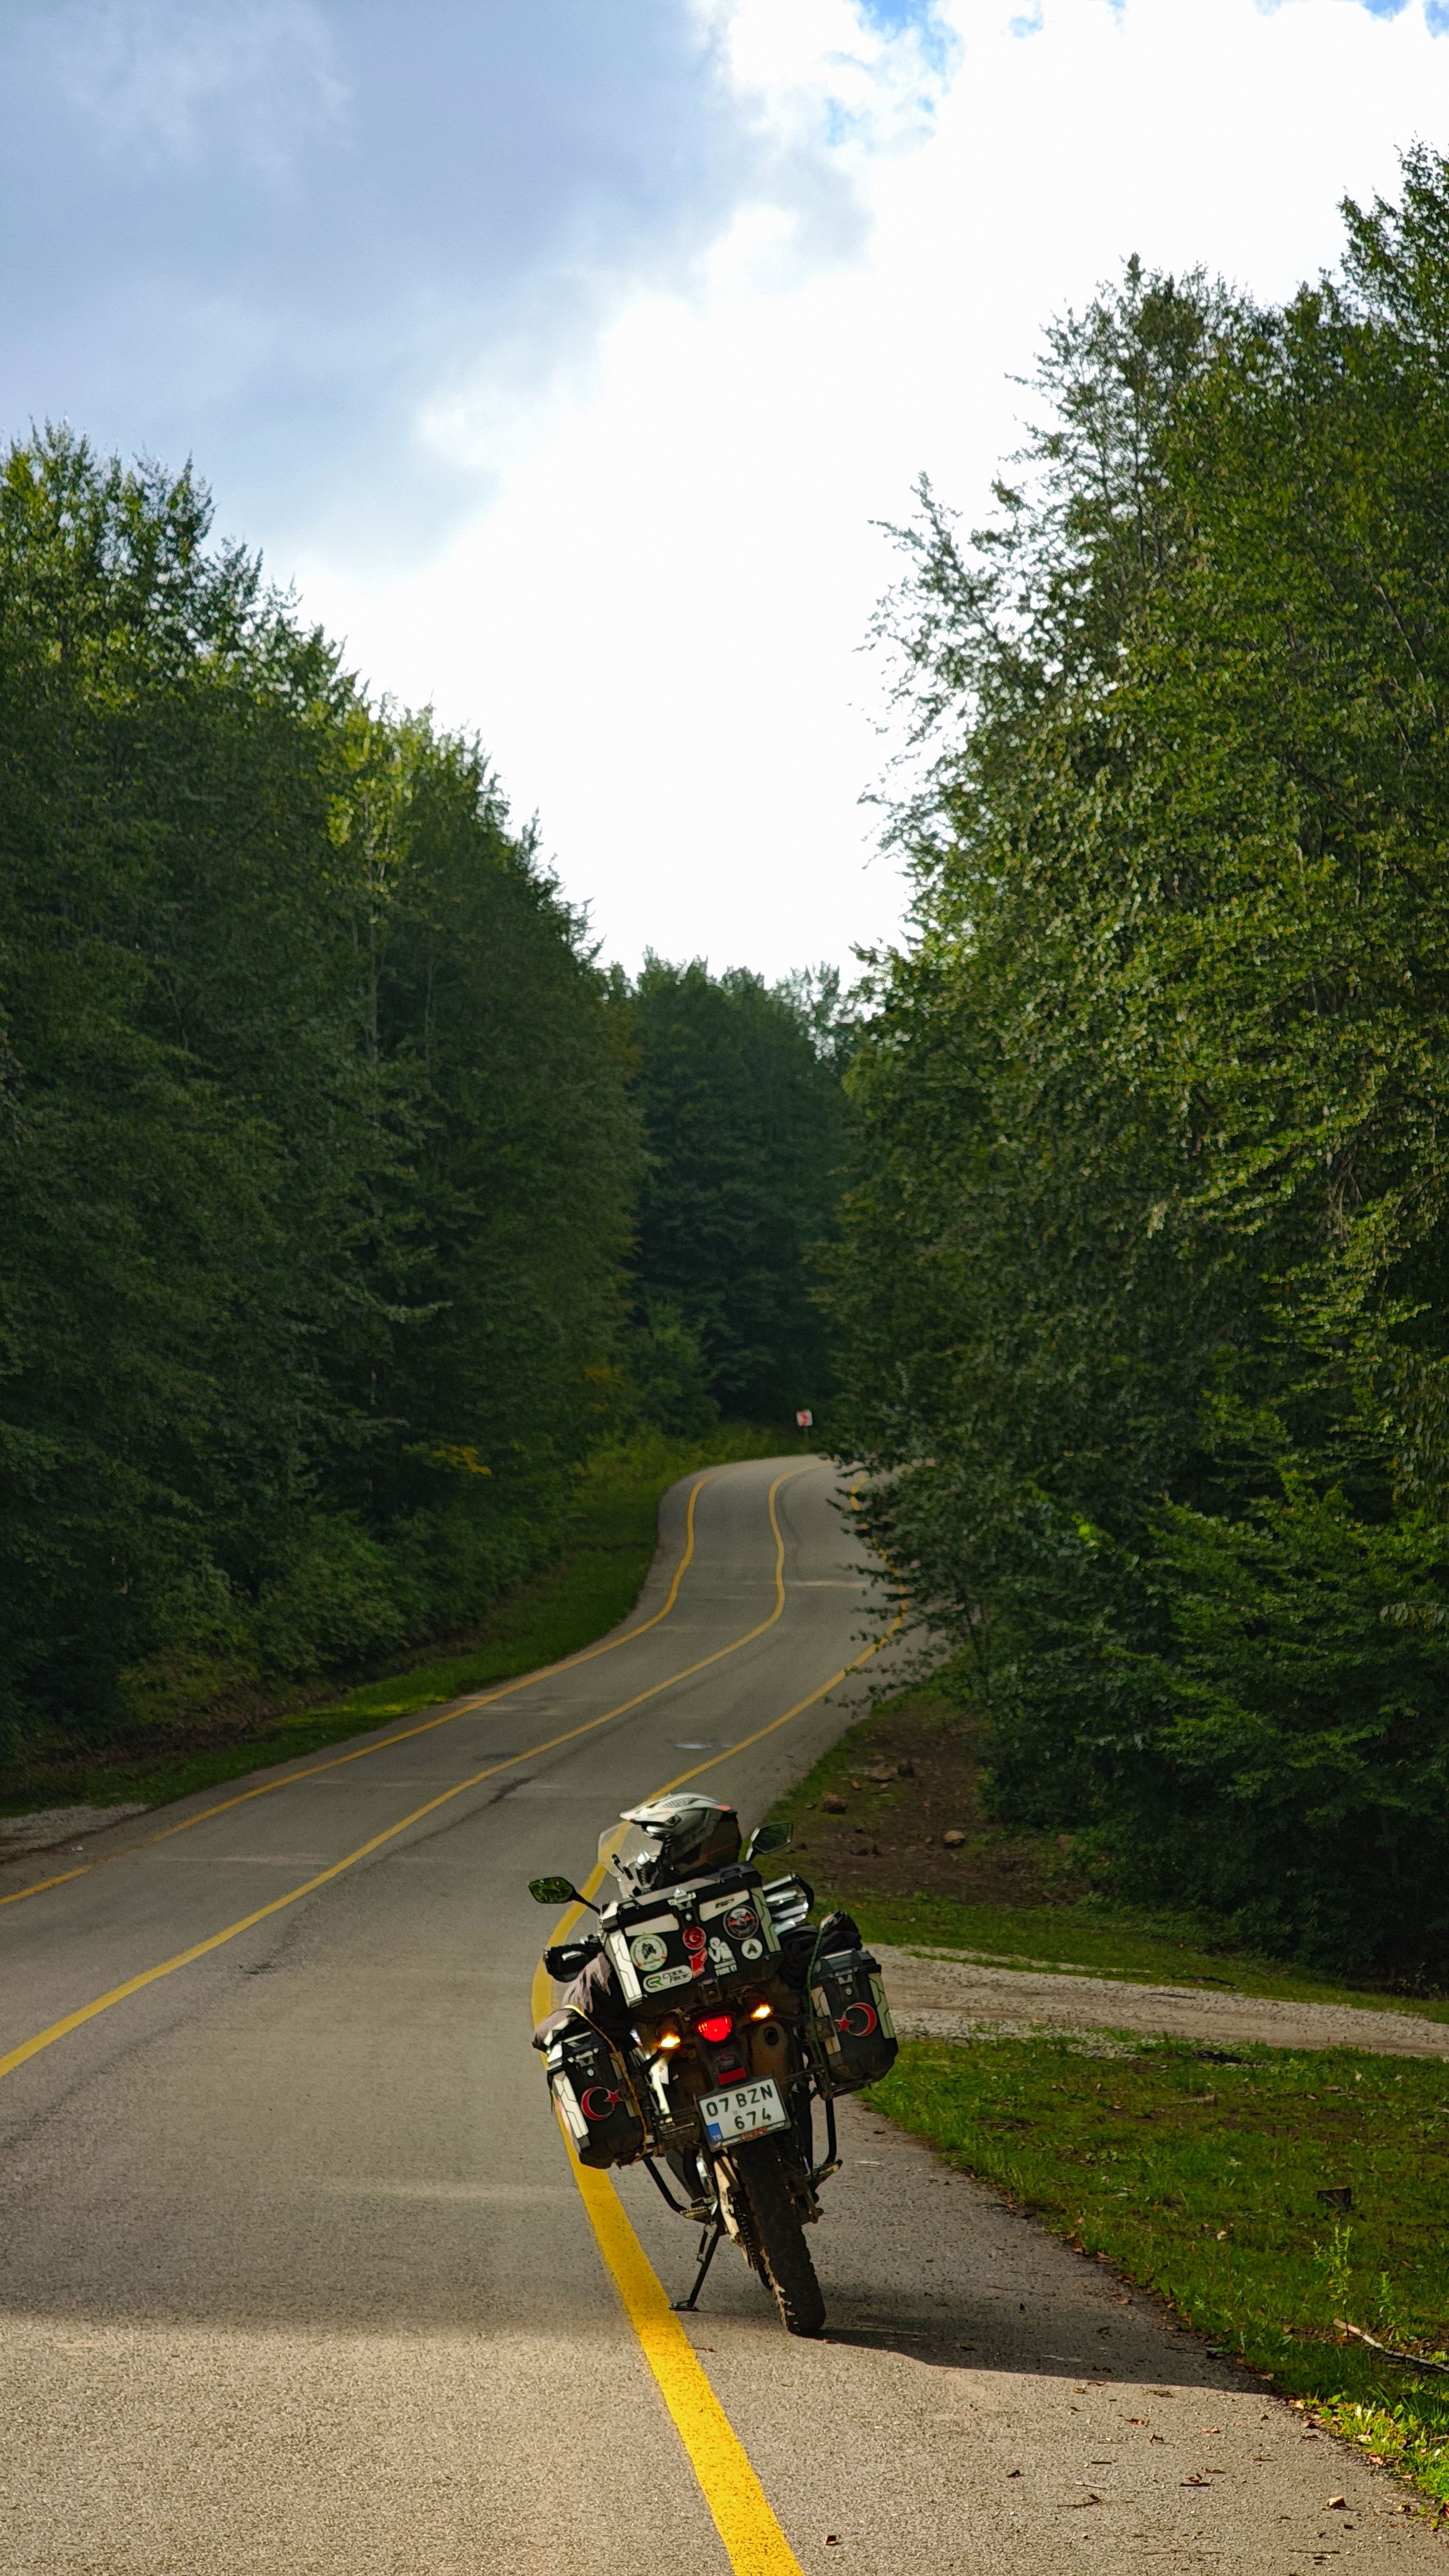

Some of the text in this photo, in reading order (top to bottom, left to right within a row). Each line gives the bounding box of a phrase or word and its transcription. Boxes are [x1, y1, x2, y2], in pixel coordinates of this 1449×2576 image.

[706, 2085, 773, 2117] 07 BZN
[735, 2108, 772, 2129] 674
